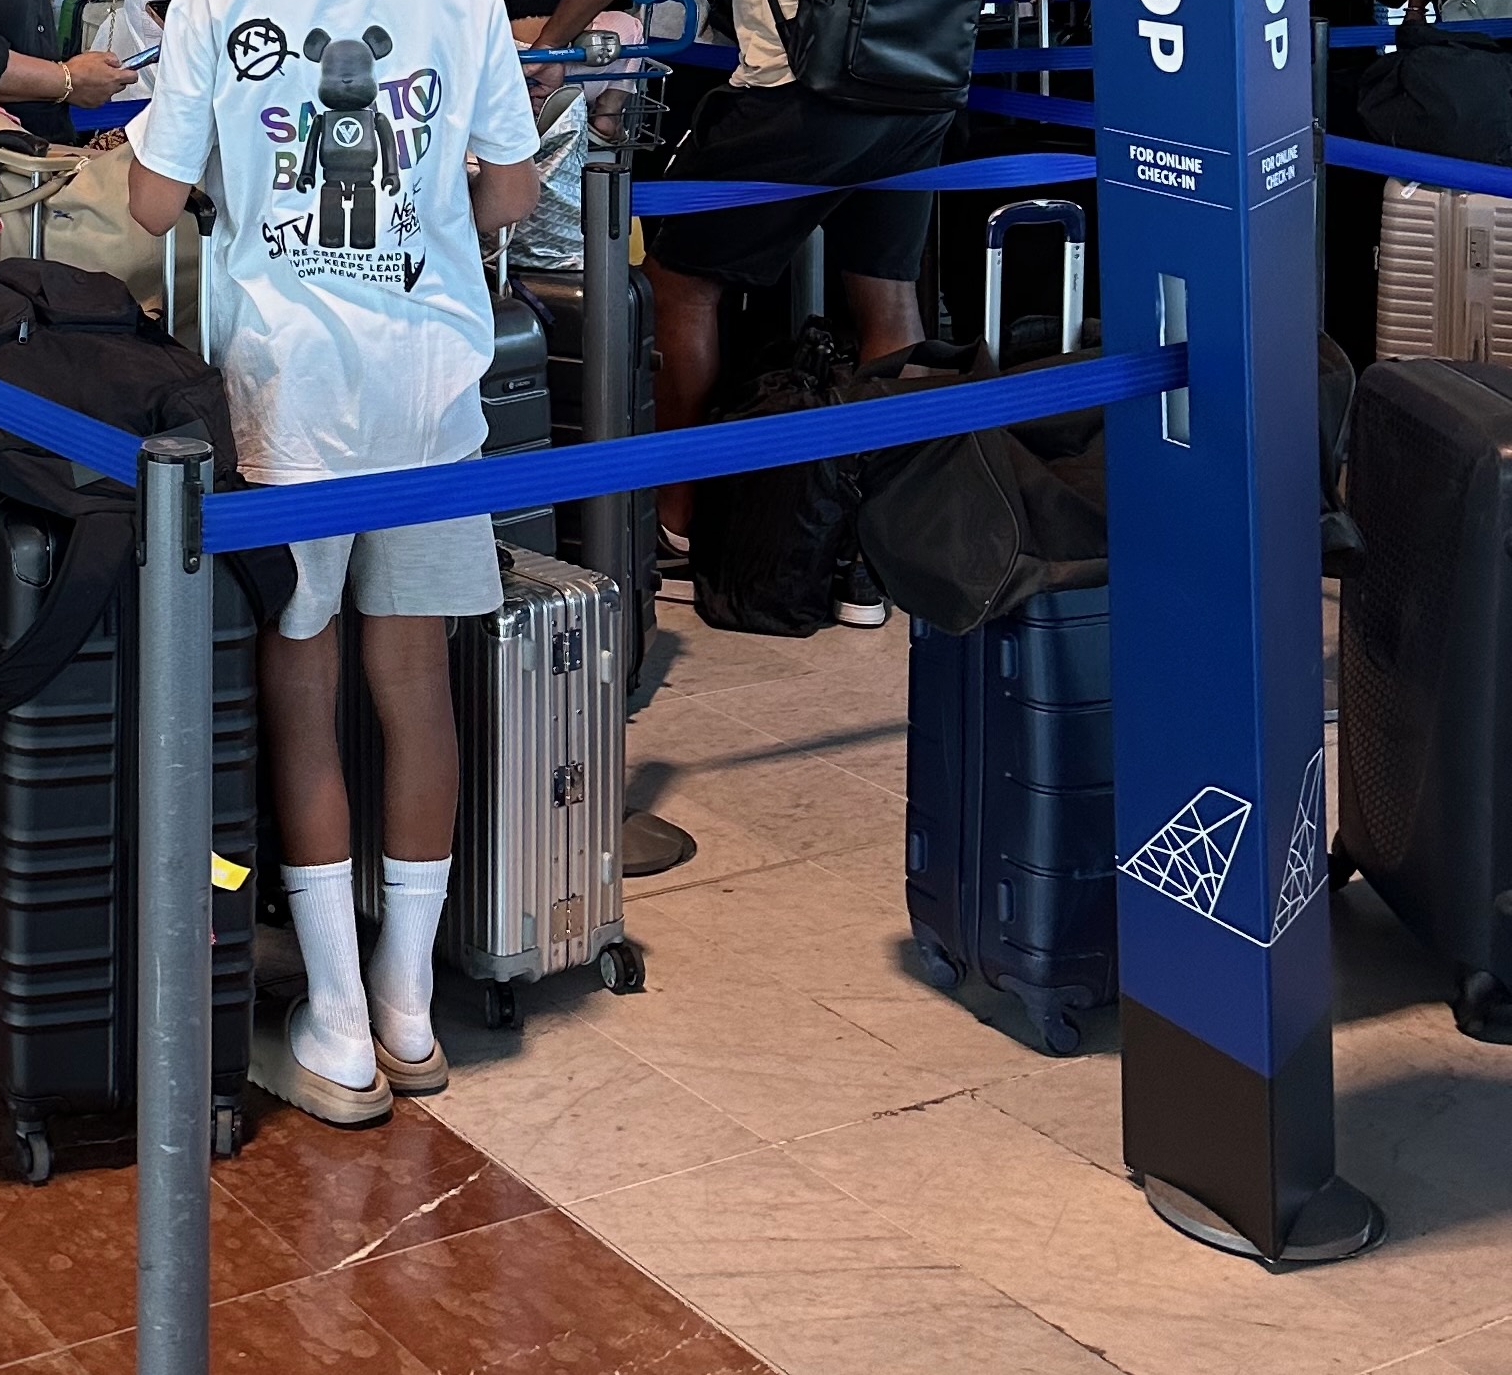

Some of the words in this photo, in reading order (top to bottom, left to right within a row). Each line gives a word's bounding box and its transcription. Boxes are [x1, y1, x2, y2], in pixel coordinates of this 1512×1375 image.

[1129, 145, 1155, 165] FOR
[1156, 151, 1203, 175] ONLINE
[1261, 159, 1275, 174] FOR
[1275, 144, 1299, 169] ONLINE
[1137, 164, 1196, 191] CHECK-IN
[1265, 164, 1296, 191] CHECK-IN
[313, 250, 373, 262] CREATIVE
[377, 252, 402, 262] AND
[324, 258, 365, 271] KEEPS
[298, 266, 325, 279] OWN
[329, 267, 357, 279] NEW
[362, 273, 402, 283] PATHS
